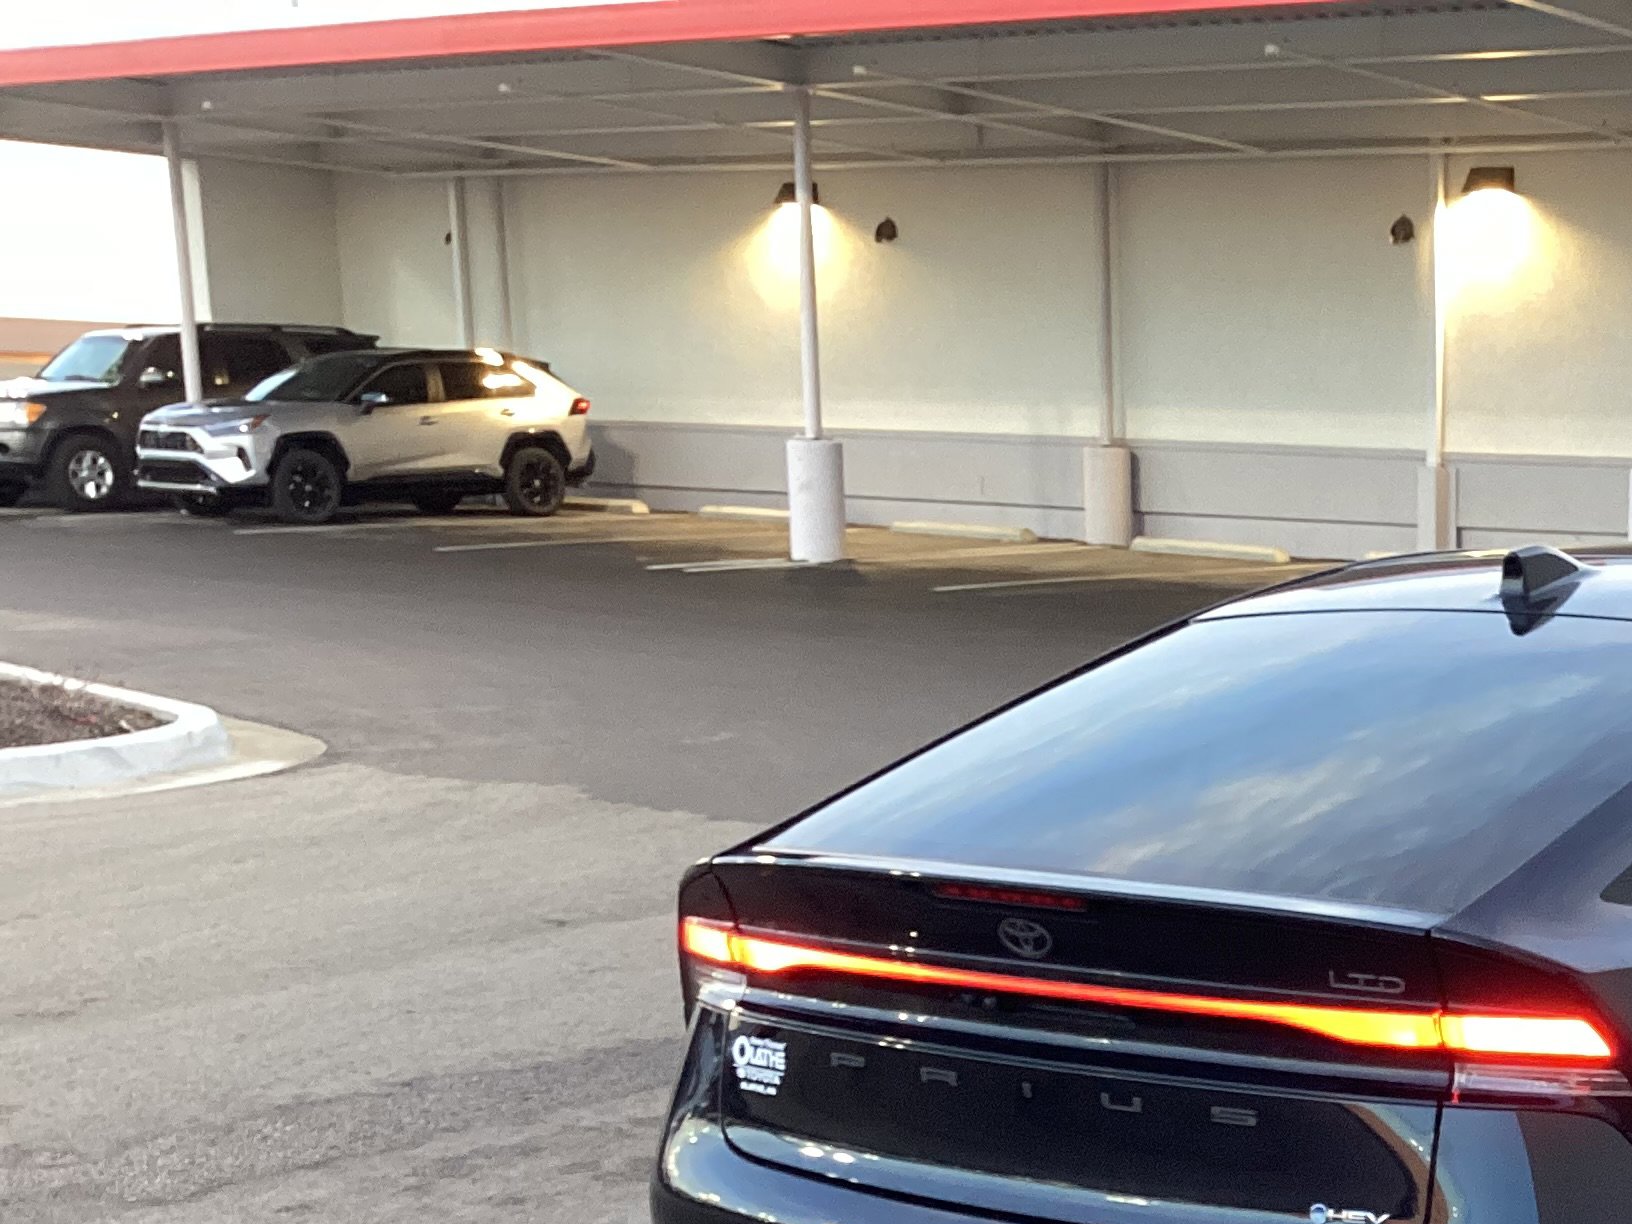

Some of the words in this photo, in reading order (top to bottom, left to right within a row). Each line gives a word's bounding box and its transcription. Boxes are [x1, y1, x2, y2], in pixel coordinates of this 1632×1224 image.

[1328, 969, 1406, 994] LTD
[732, 1035, 786, 1071] OLATHE
[829, 1051, 1257, 1127] PRIUS
[1327, 1208, 1391, 1224] HEV
